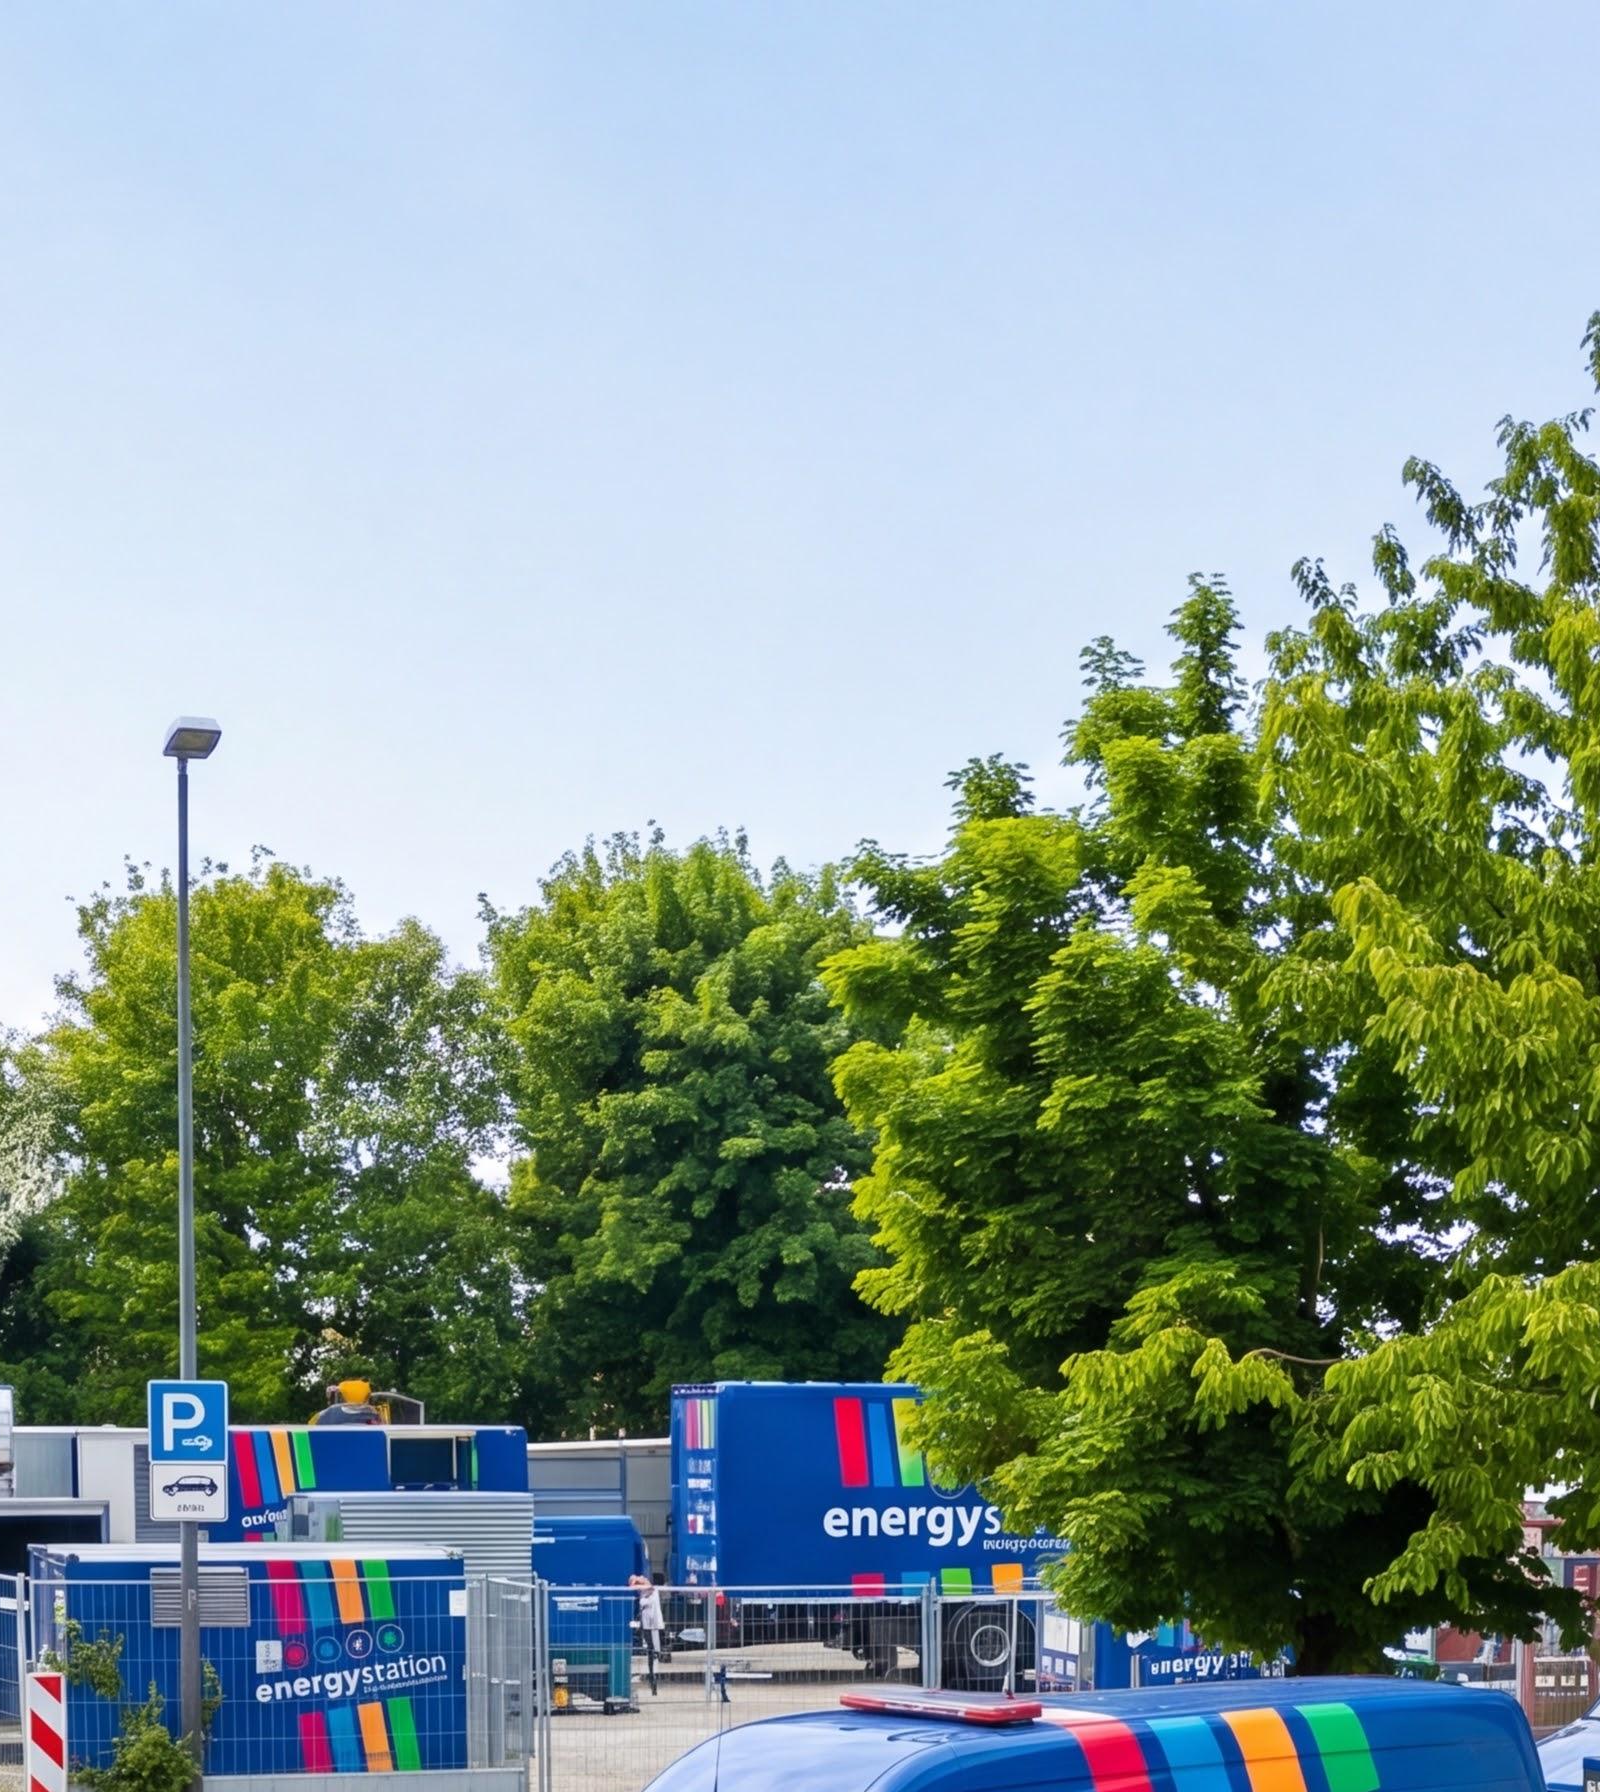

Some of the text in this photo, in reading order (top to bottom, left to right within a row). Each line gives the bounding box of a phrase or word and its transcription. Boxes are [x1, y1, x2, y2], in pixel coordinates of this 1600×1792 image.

[163, 1393, 205, 1451] P
[823, 1505, 1001, 1547] energys
[255, 1654, 447, 1702] energystation
